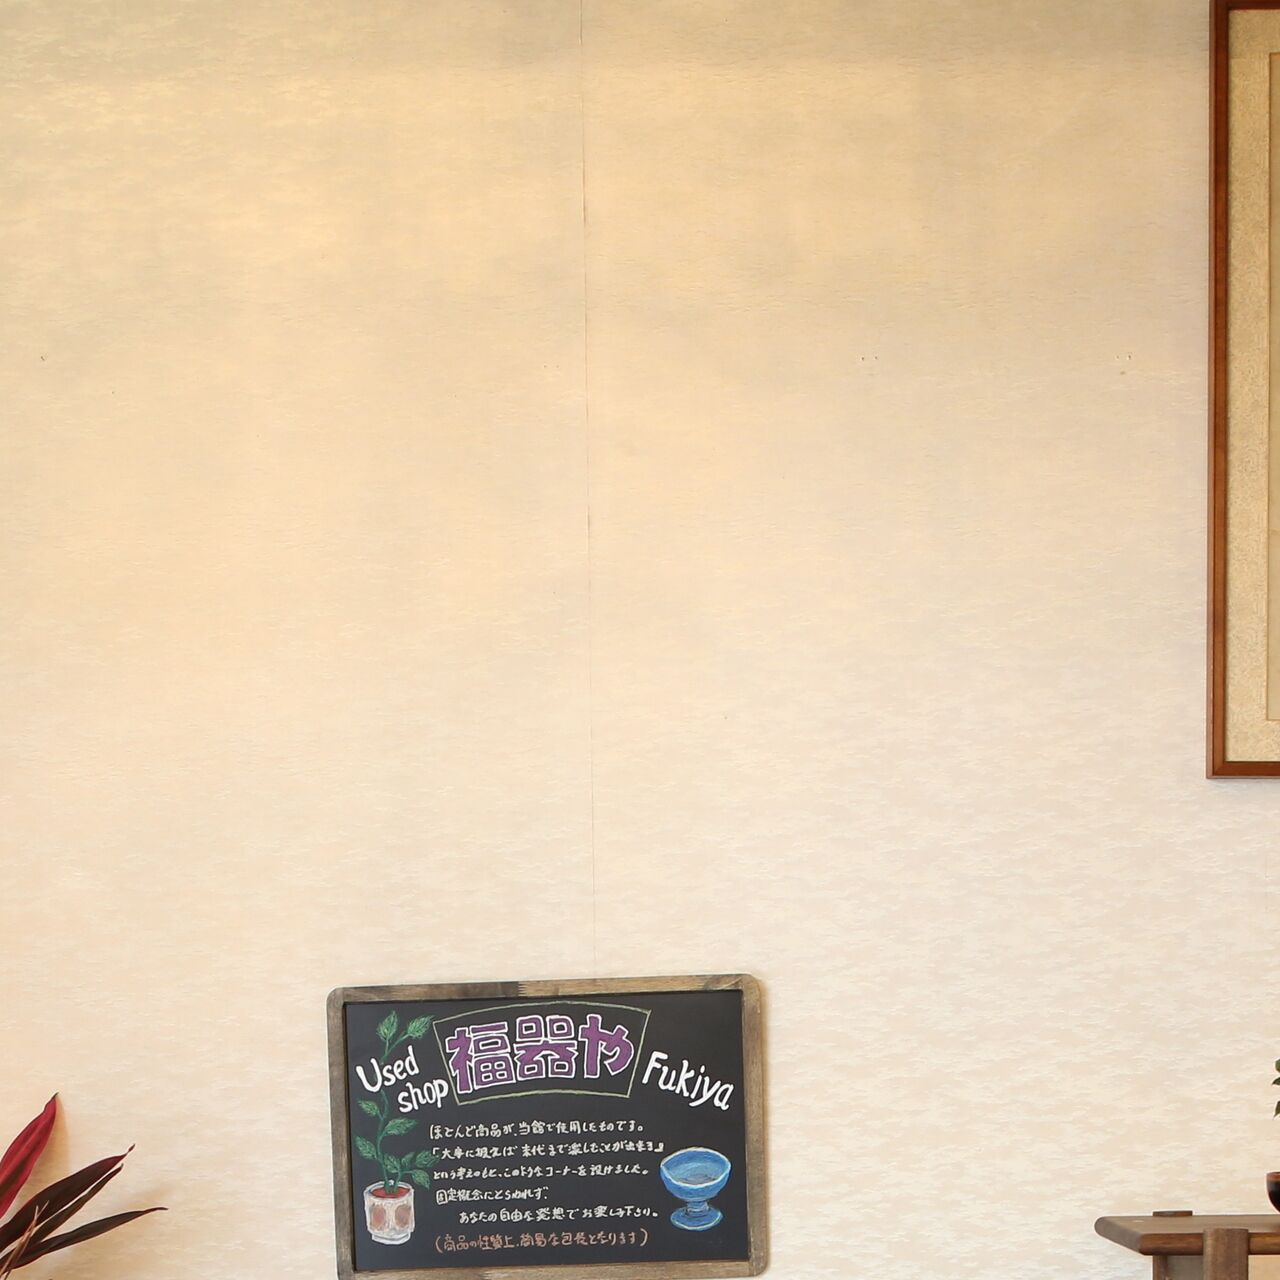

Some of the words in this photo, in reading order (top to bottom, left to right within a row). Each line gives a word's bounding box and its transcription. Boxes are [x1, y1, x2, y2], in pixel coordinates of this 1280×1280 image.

[356, 1045, 419, 1092] Used
[445, 1014, 634, 1094] 福器や
[642, 1051, 734, 1110] Fukiya
[397, 1079, 449, 1113] shop
